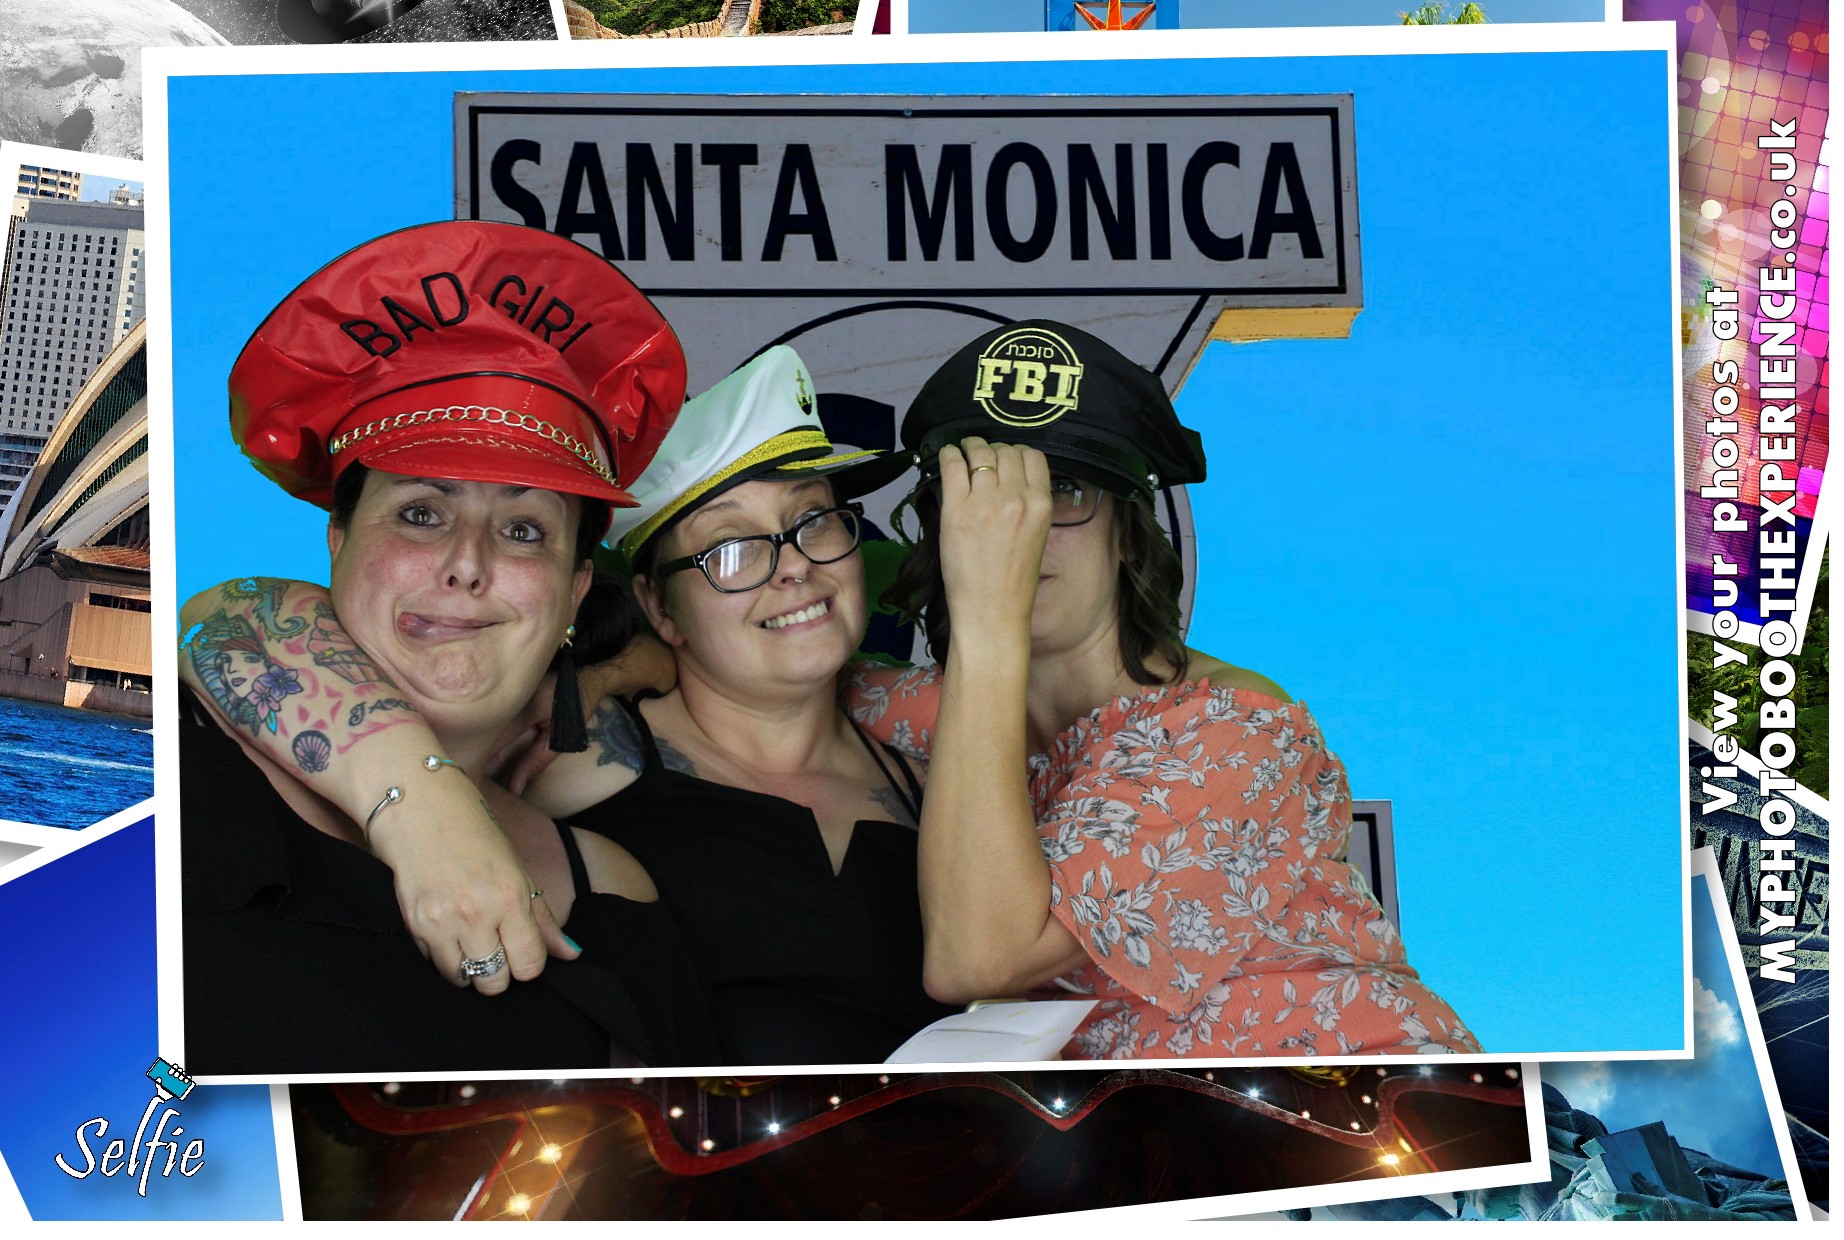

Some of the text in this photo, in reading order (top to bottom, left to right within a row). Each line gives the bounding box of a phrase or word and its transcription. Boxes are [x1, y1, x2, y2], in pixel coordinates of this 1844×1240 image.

[490, 138, 1324, 263] SANTA MONICA
[339, 271, 470, 358] BAD
[973, 356, 1083, 409] FBI
